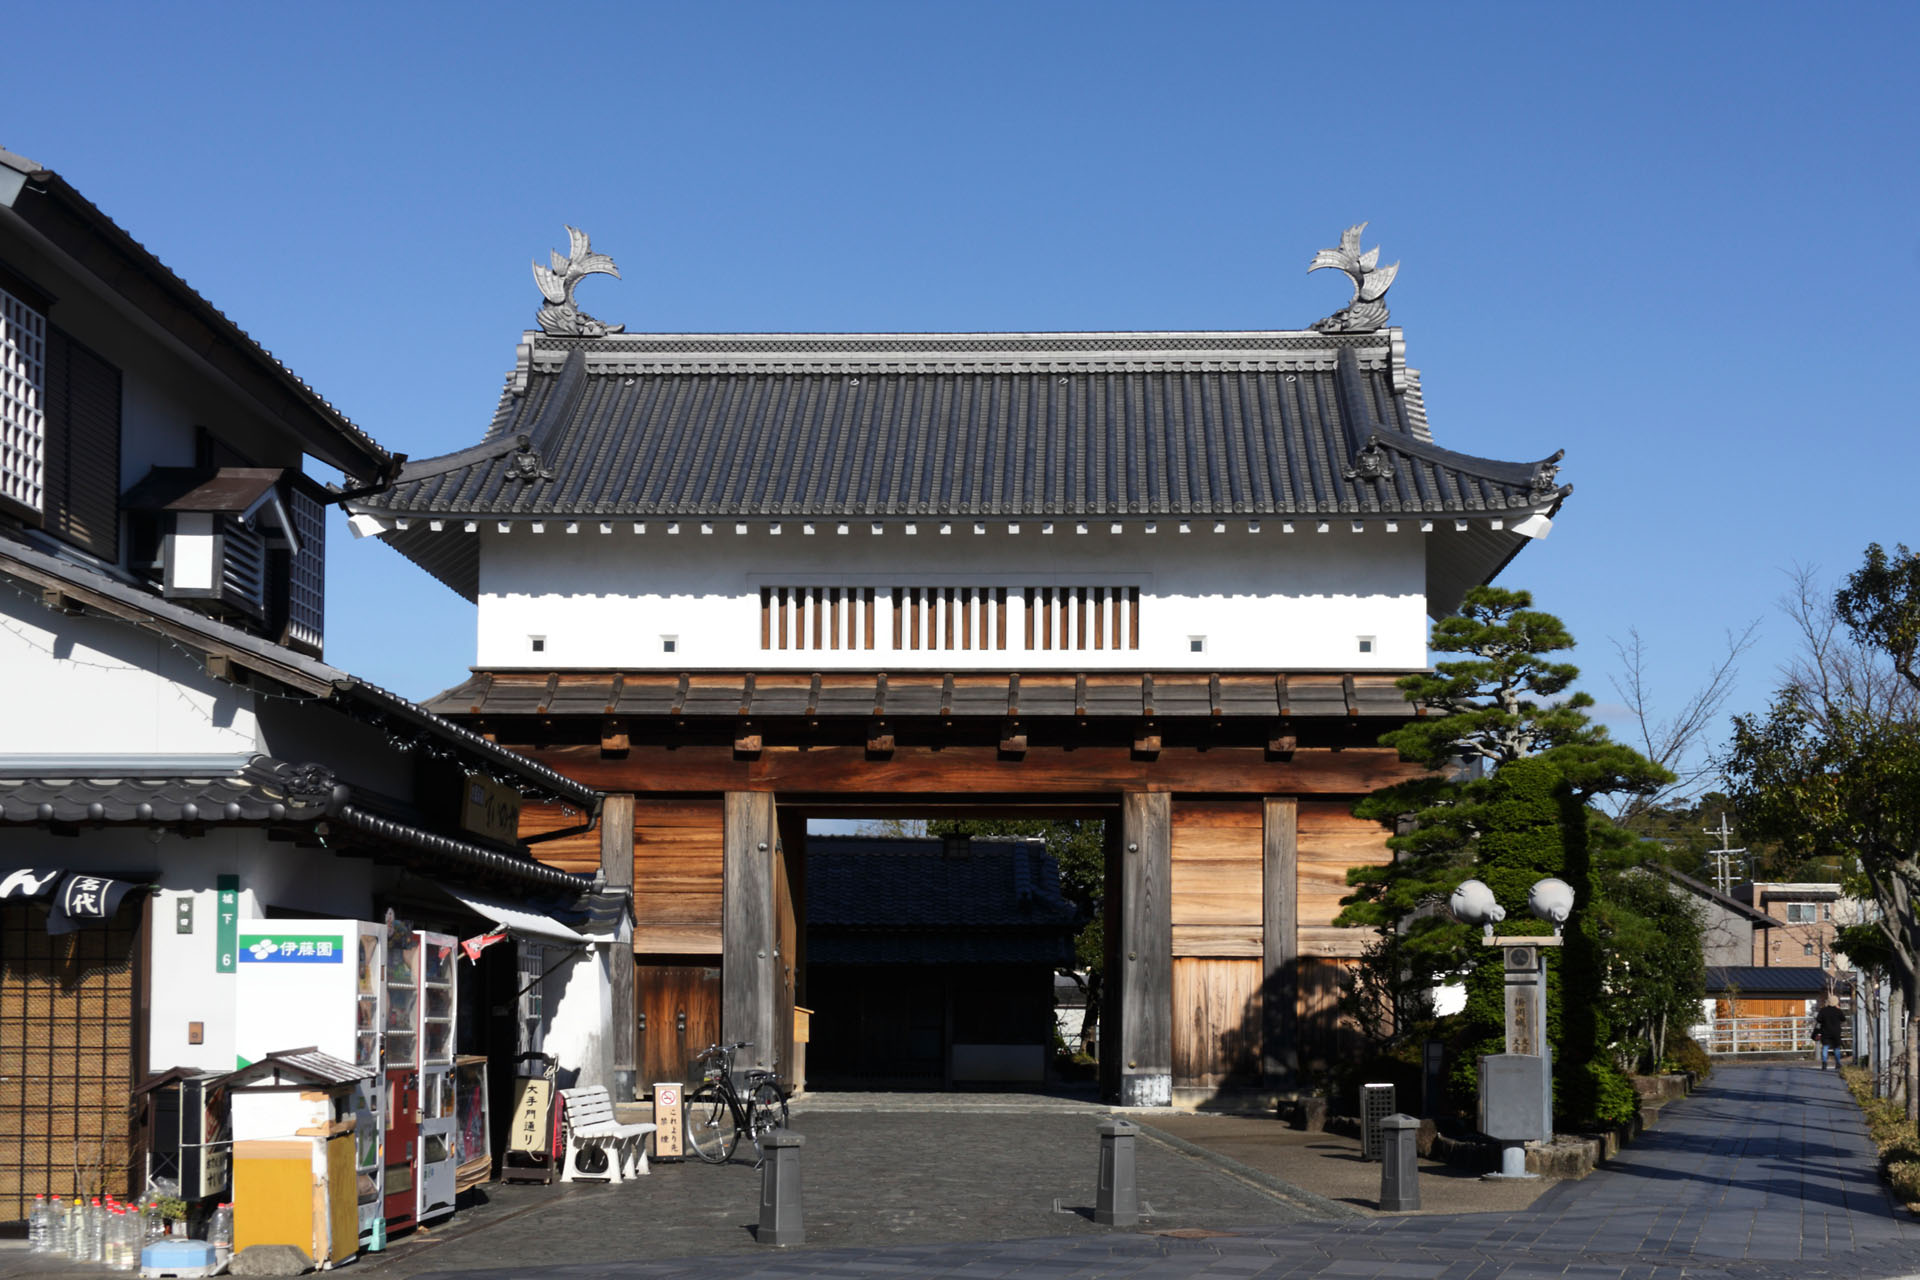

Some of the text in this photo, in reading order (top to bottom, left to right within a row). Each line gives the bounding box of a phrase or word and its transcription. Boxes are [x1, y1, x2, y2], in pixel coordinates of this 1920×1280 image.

[72, 878, 101, 914] 名代
[222, 893, 233, 966] 城下 6
[280, 941, 332, 956] 伊藤園
[523, 1085, 538, 1145] 大手門通り
[660, 1117, 669, 1144] 禁煙
[670, 1109, 679, 1152] これより先
